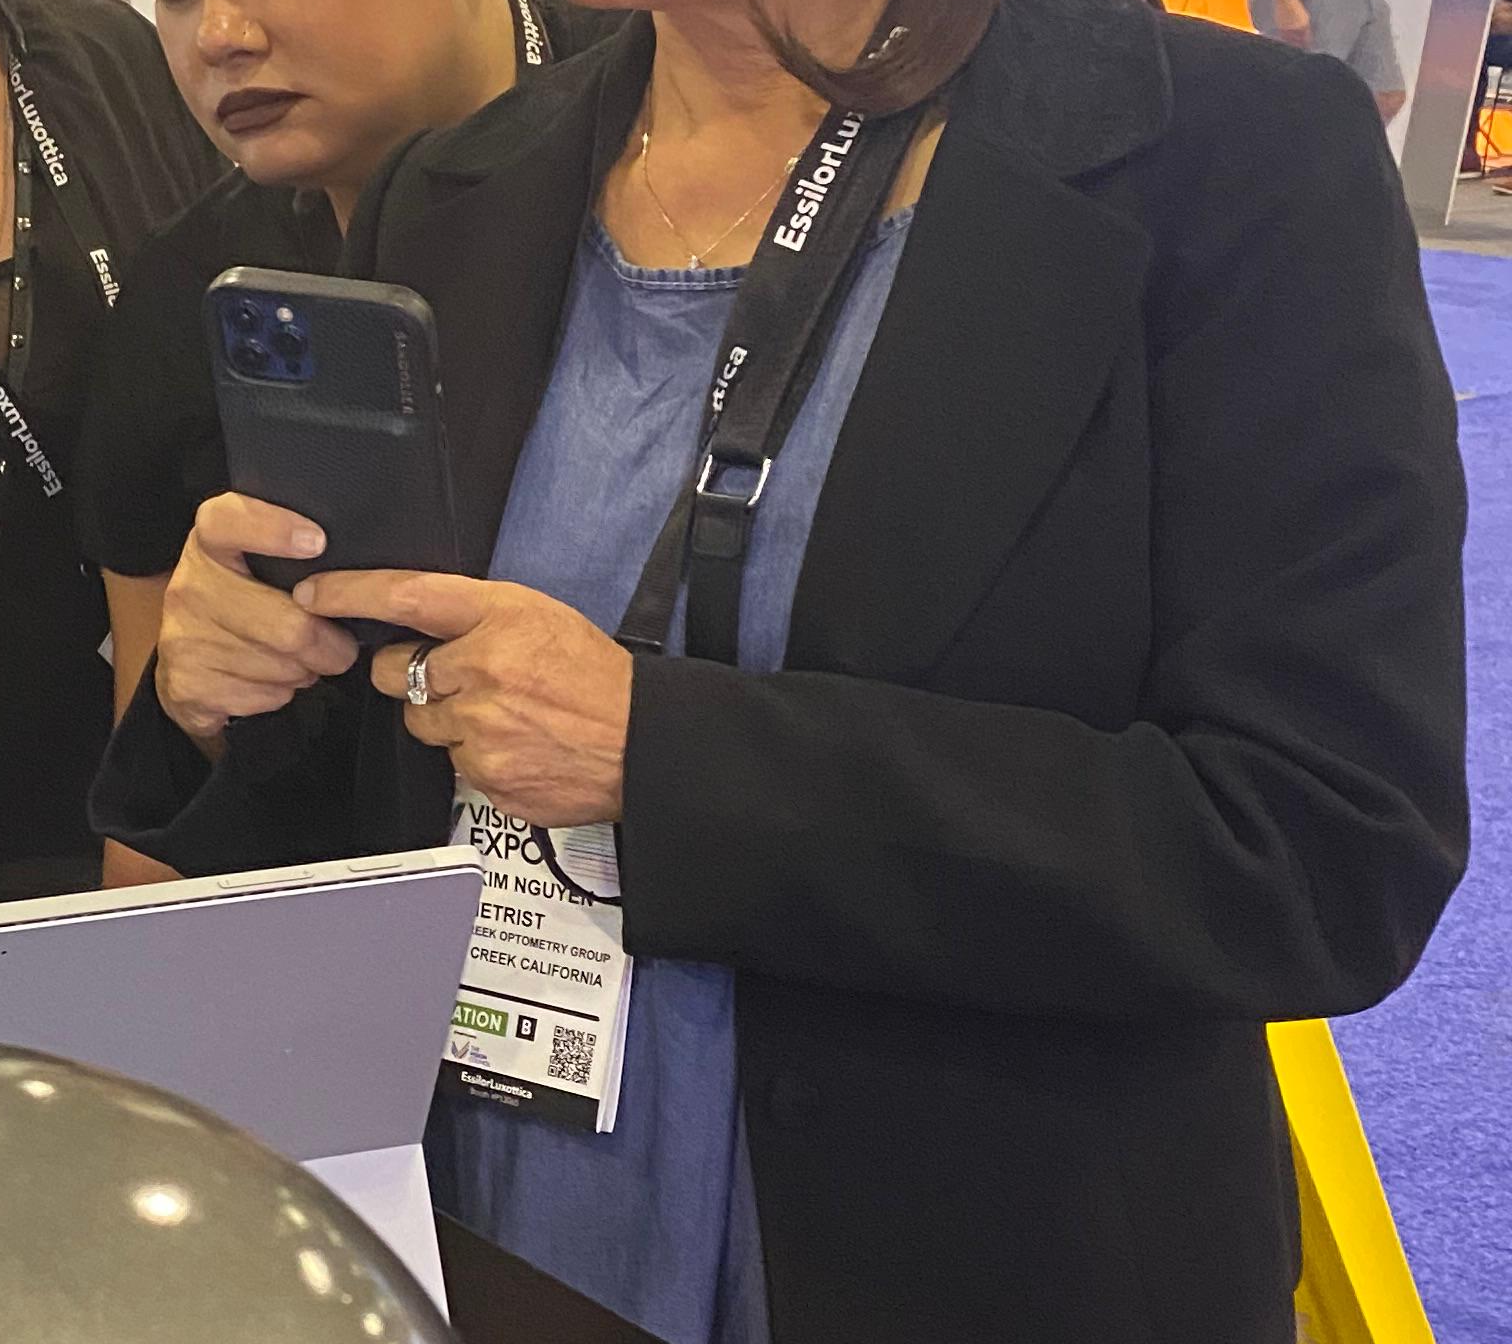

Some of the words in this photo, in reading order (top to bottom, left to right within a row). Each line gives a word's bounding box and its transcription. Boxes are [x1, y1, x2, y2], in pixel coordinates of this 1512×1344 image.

[469, 803, 528, 832] VISIO
[470, 827, 544, 865] EXPO
[478, 902, 546, 930] ETRIST
[500, 931, 569, 955] OPTOMETRY
[570, 946, 611, 964] GROUP
[470, 946, 517, 969] CREEK
[520, 958, 603, 988] CALIFORNIA
[461, 1071, 533, 1100] EssilorLuxottica
